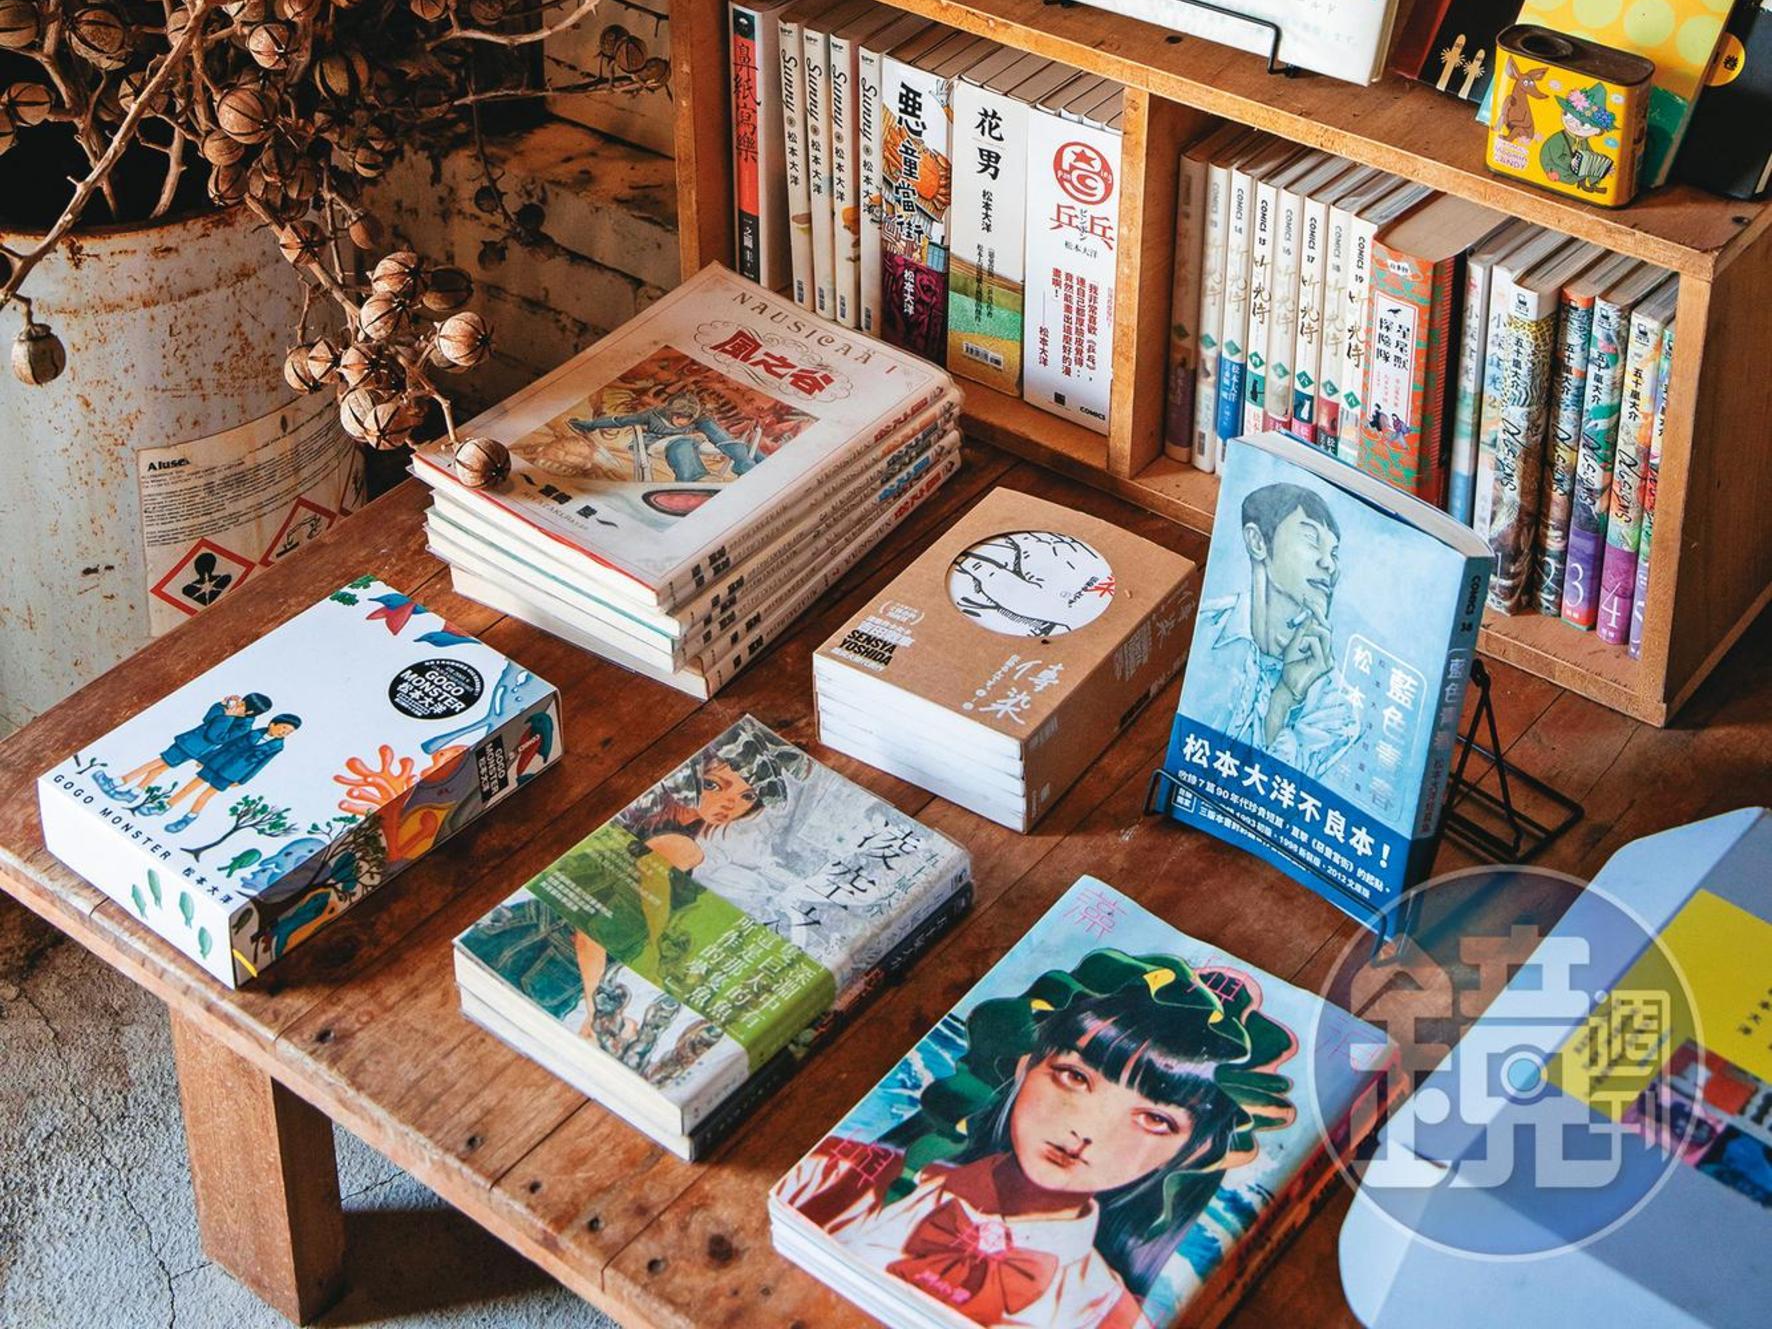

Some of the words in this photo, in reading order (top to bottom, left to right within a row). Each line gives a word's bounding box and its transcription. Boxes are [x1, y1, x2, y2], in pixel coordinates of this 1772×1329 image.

[781, 49, 798, 113] Sunny
[805, 57, 822, 121] Sunny
[831, 64, 847, 129] Sunny
[859, 77, 877, 142] Sunny
[975, 106, 1004, 180] 花男
[1260, 199, 1268, 232] COMICS
[1308, 216, 1317, 250] COMICS
[1356, 236, 1366, 270] COMICS
[710, 328, 839, 402] 風之谷
[1565, 563, 1584, 607] 3
[1602, 582, 1621, 629] 4
[839, 638, 893, 666] YOSHIDA
[847, 630, 898, 655] SENSYA
[400, 669, 466, 712] MONSTER
[425, 671, 465, 696] GOGO
[486, 743, 500, 794] MONSTER
[495, 748, 506, 779] GOGO
[53, 774, 94, 804] GOGO
[100, 808, 171, 861] MONSTER
[1182, 733, 1391, 869] 松本大洋不良本！
[763, 820, 921, 935] 凌空之
